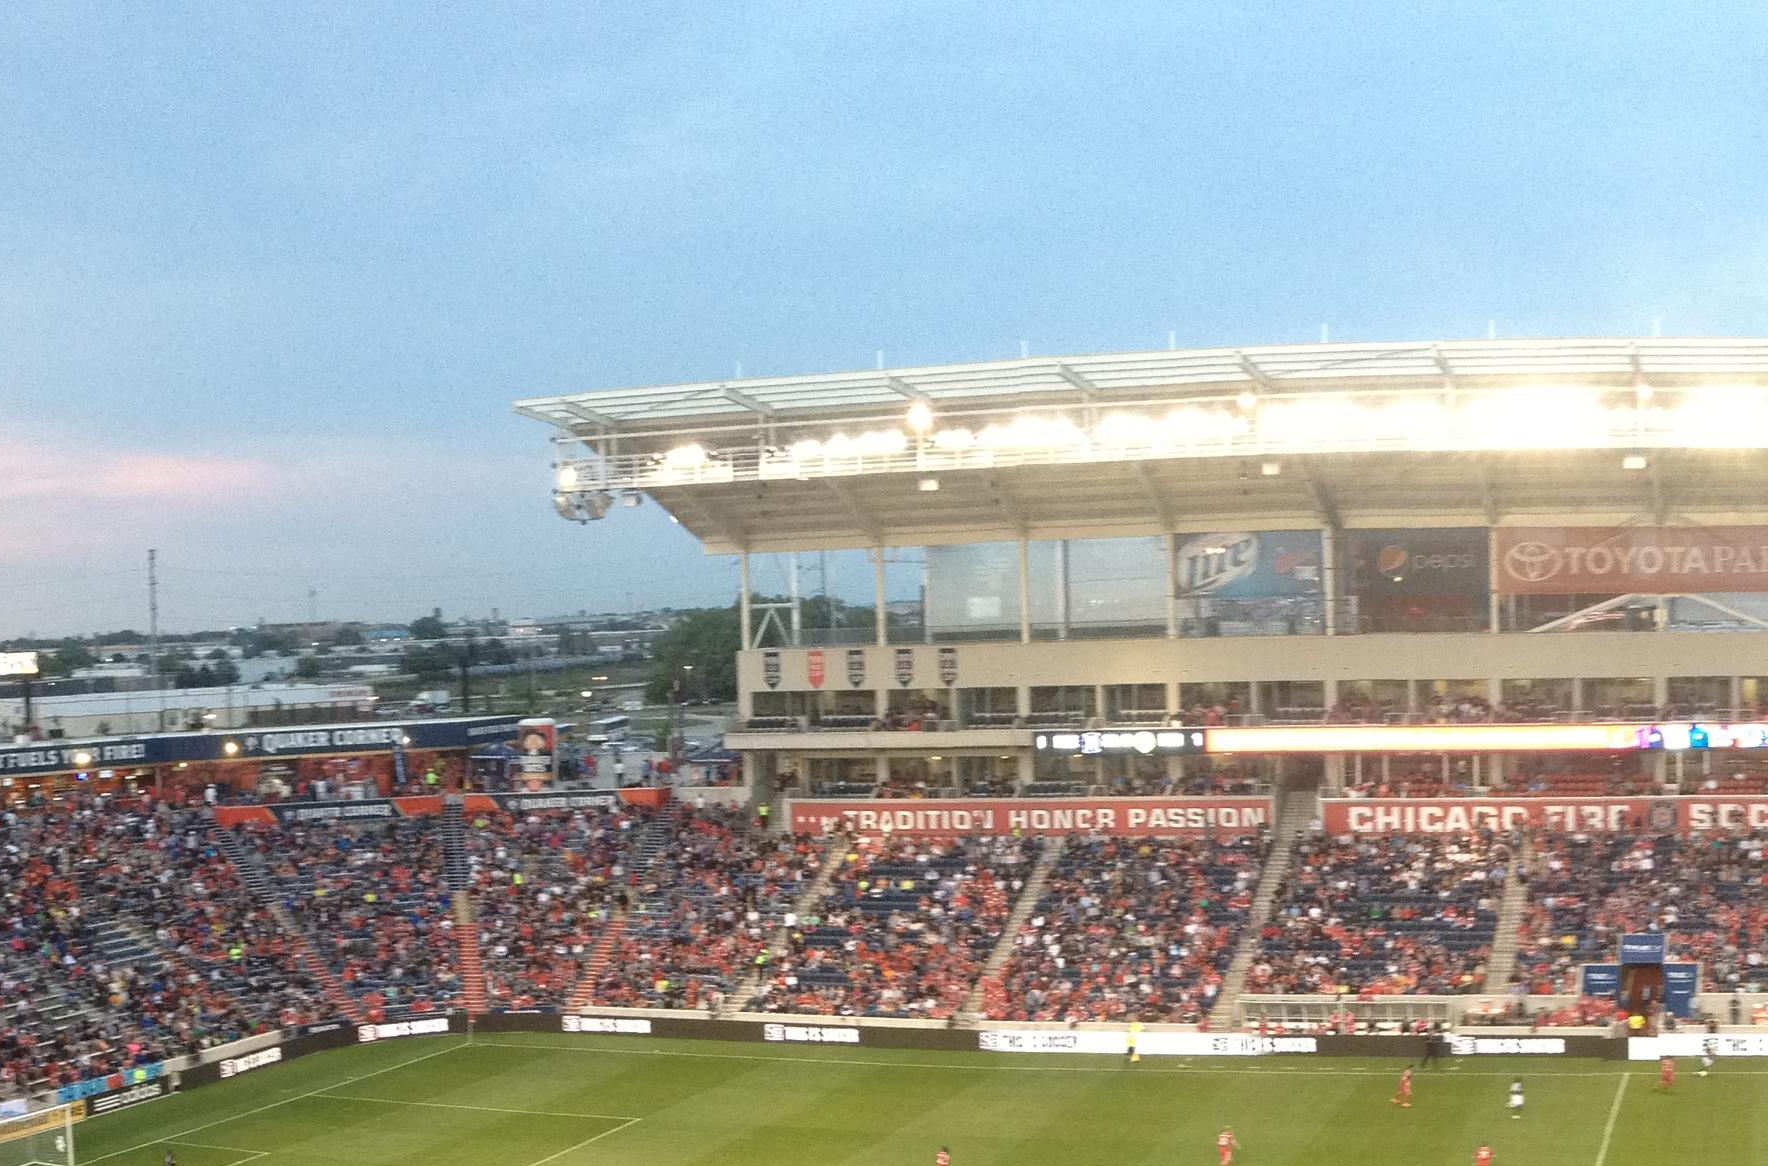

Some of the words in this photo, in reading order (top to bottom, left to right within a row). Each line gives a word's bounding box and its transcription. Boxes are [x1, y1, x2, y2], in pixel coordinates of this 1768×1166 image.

[1413, 552, 1475, 572] pepsi
[1564, 545, 1710, 574] TOYOTA
[262, 731, 330, 753] QUAKER
[334, 728, 403, 746] CORNER
[1127, 807, 1266, 828] PASSION
